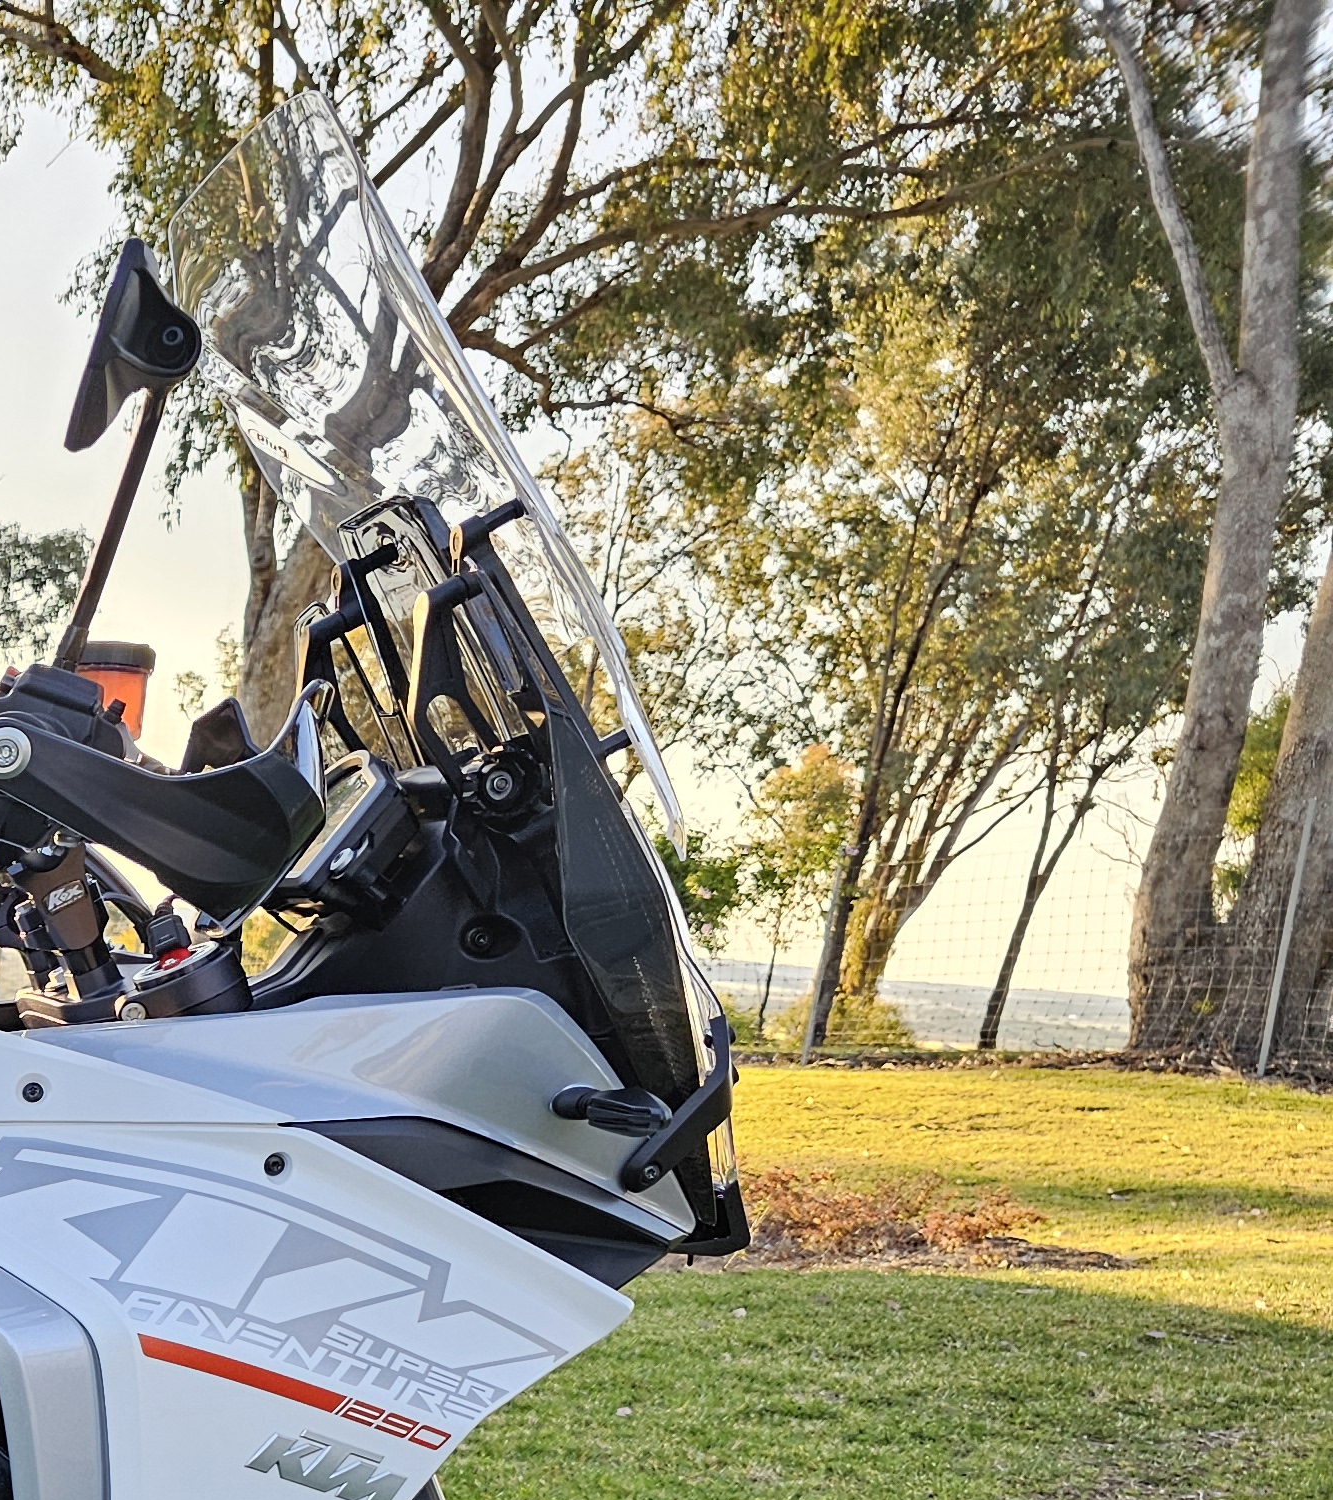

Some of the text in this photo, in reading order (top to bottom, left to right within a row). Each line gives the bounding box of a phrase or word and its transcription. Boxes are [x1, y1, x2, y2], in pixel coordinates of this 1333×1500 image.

[128, 1290, 491, 1421] ADVENTURE
[321, 1324, 500, 1405] SUPER
[334, 1397, 452, 1451] 1290
